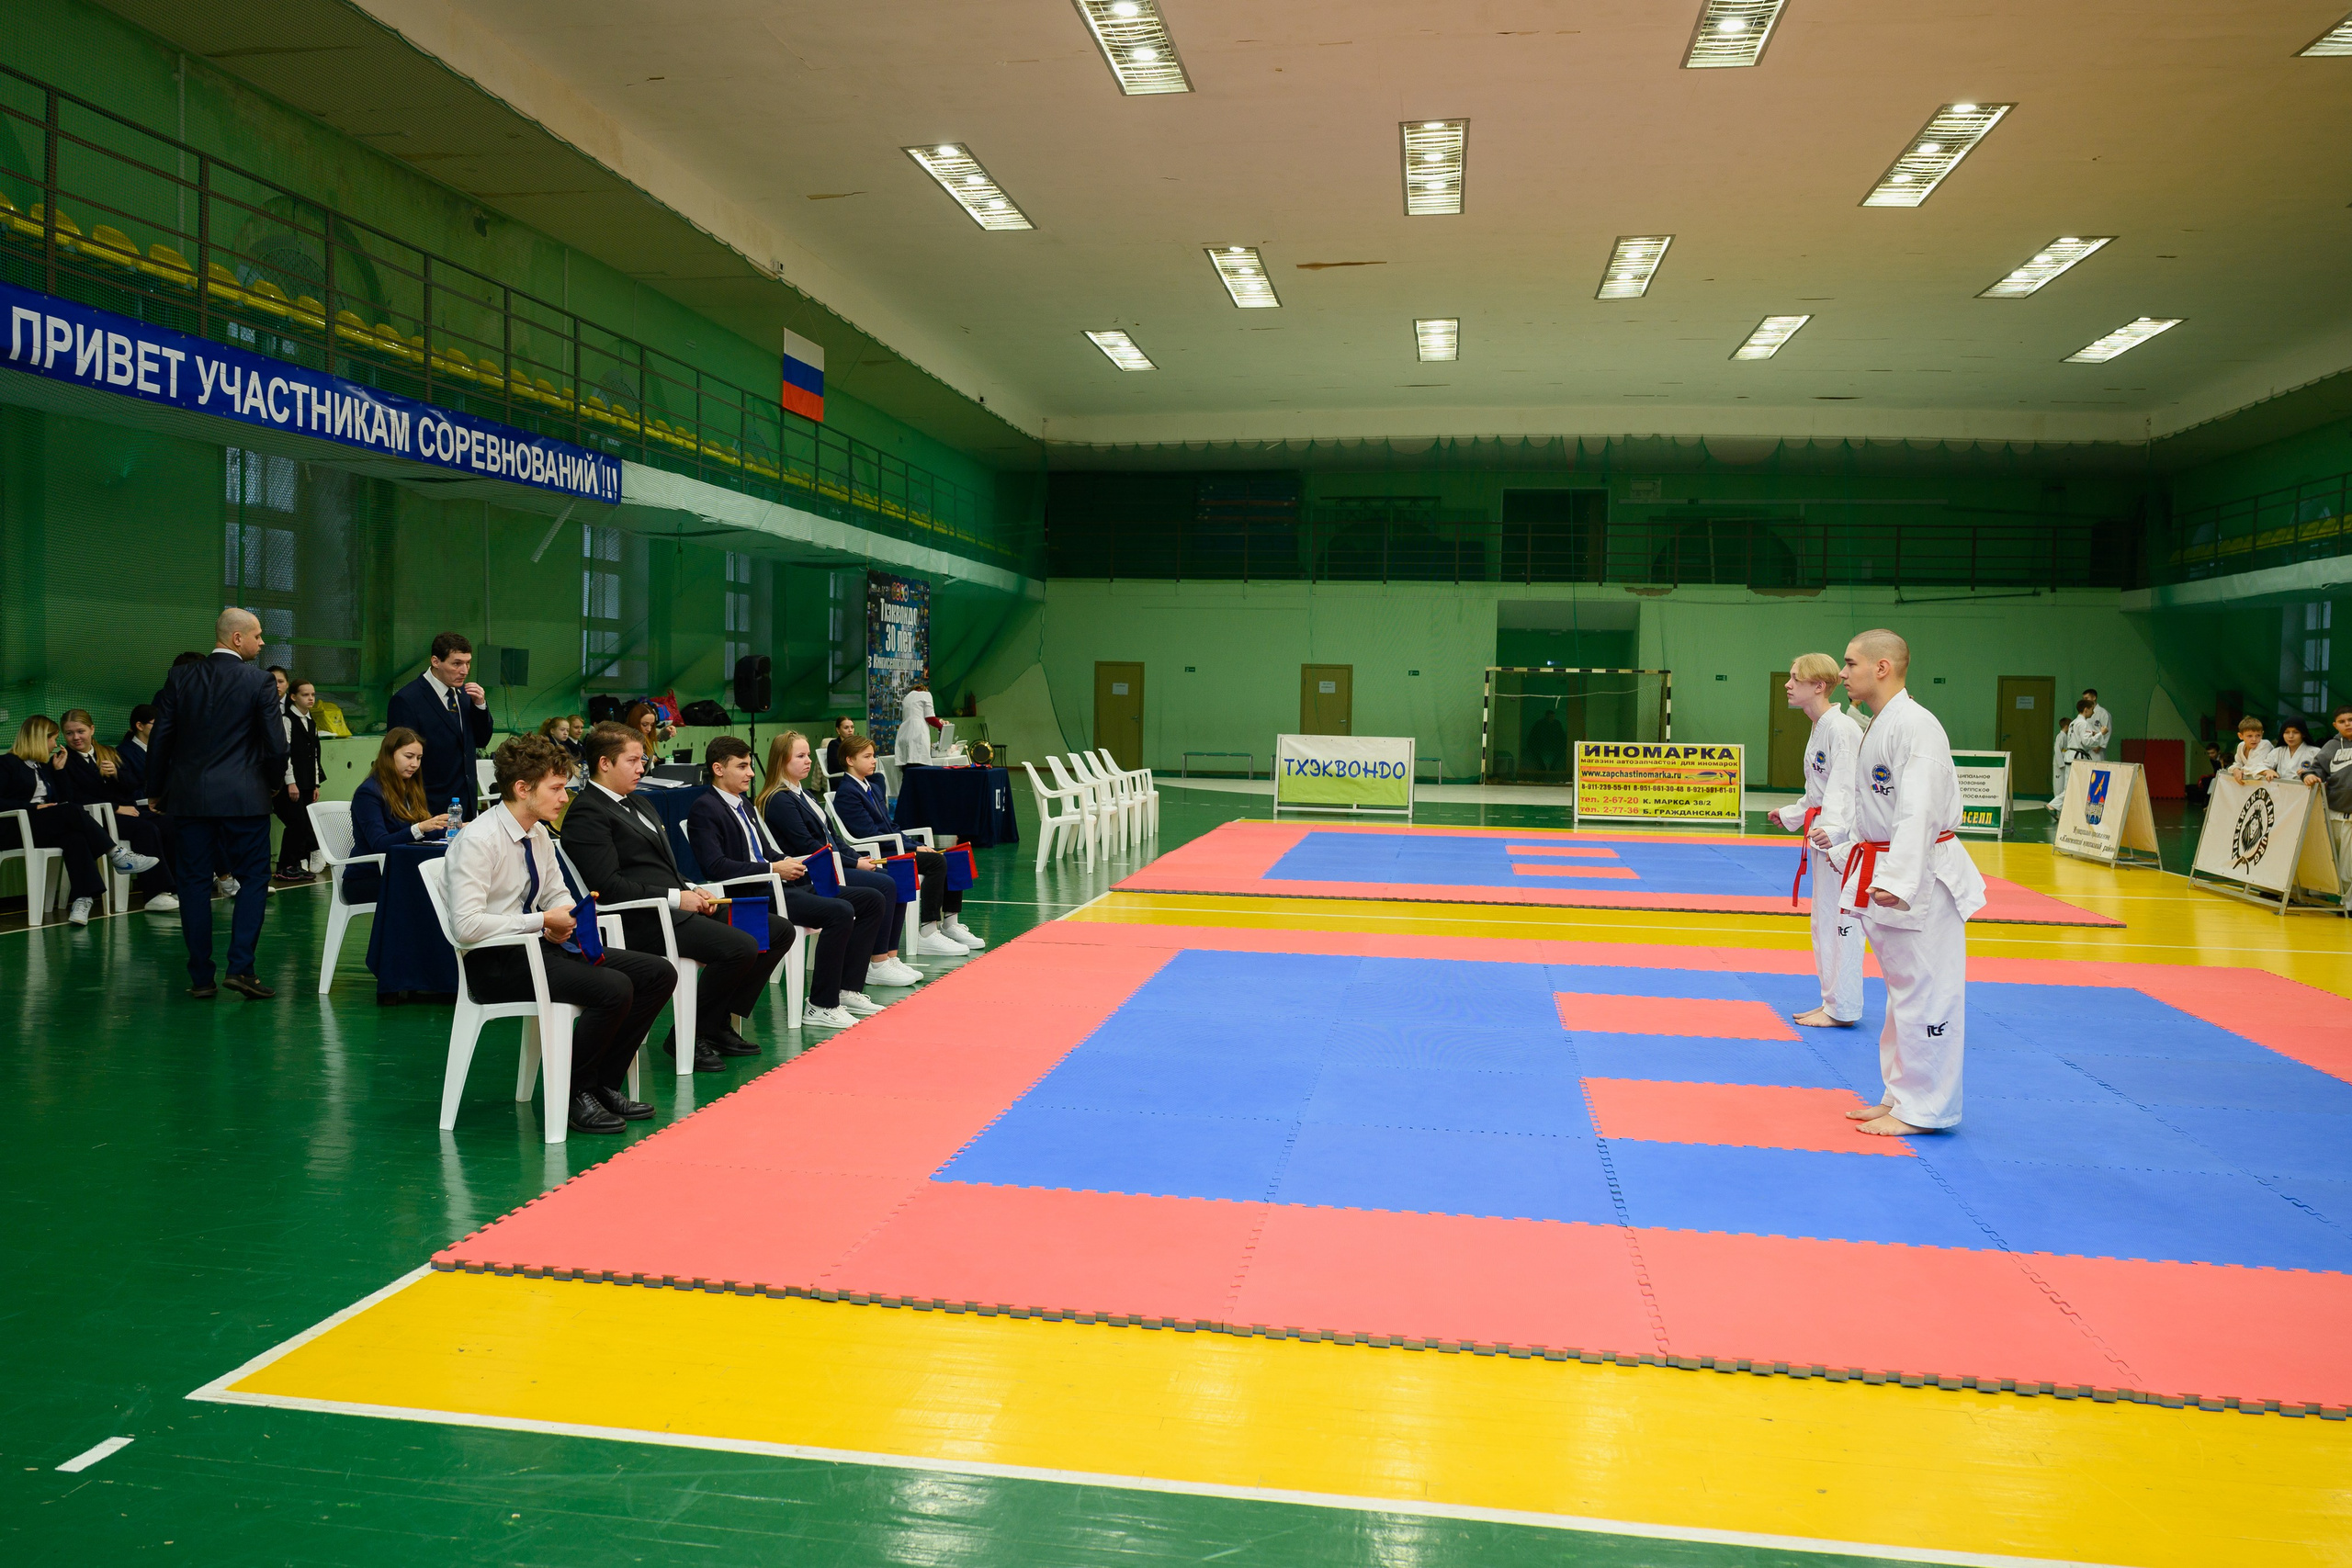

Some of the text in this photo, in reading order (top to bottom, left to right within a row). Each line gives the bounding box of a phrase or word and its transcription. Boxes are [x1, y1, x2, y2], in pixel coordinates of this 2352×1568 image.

[9, 306, 186, 399] ПРИВЕТ
[195, 355, 411, 452] УЧАСТНИКАМ
[418, 416, 599, 494] СОРЕВНОВАНИЙ
[885, 624, 912, 653] 30 лет
[1584, 745, 1735, 760] ИНОМАРКА
[1581, 770, 1681, 779] www.zapchastinomarka.ru
[1962, 811, 1993, 824] ИСЕПП
[2254, 795, 2274, 863] YAMURG
